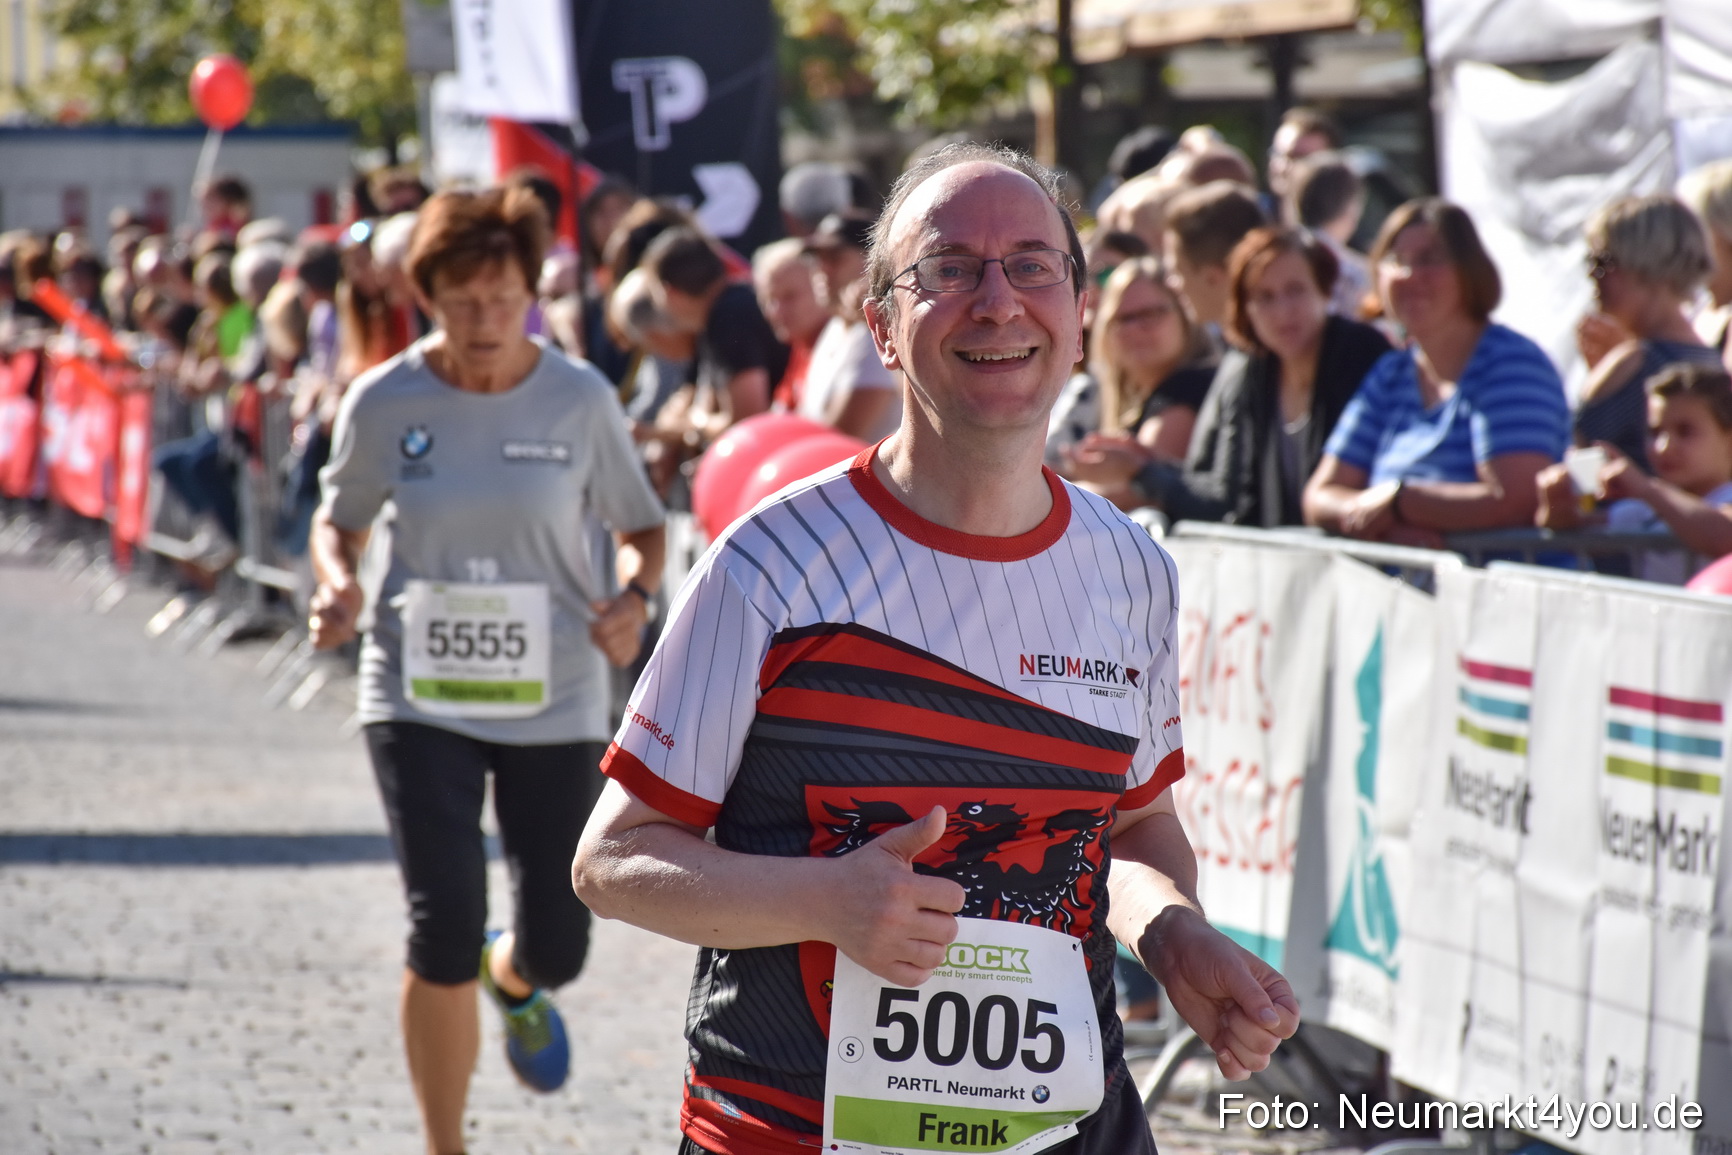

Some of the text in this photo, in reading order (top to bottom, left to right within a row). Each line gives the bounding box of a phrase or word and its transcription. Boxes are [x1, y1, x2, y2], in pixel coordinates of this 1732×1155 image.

[427, 620, 527, 660] 5555
[1089, 688, 1127, 700] STARKE STADT
[938, 942, 1032, 975] OCK
[955, 971, 967, 980] by
[968, 972, 994, 981] smart
[996, 974, 1033, 984] concepts
[872, 987, 1066, 1074] 5005
[846, 1042, 856, 1057] S
[887, 1075, 1026, 1100] PARTL Neumarkt
[918, 1112, 1009, 1146] Frank
